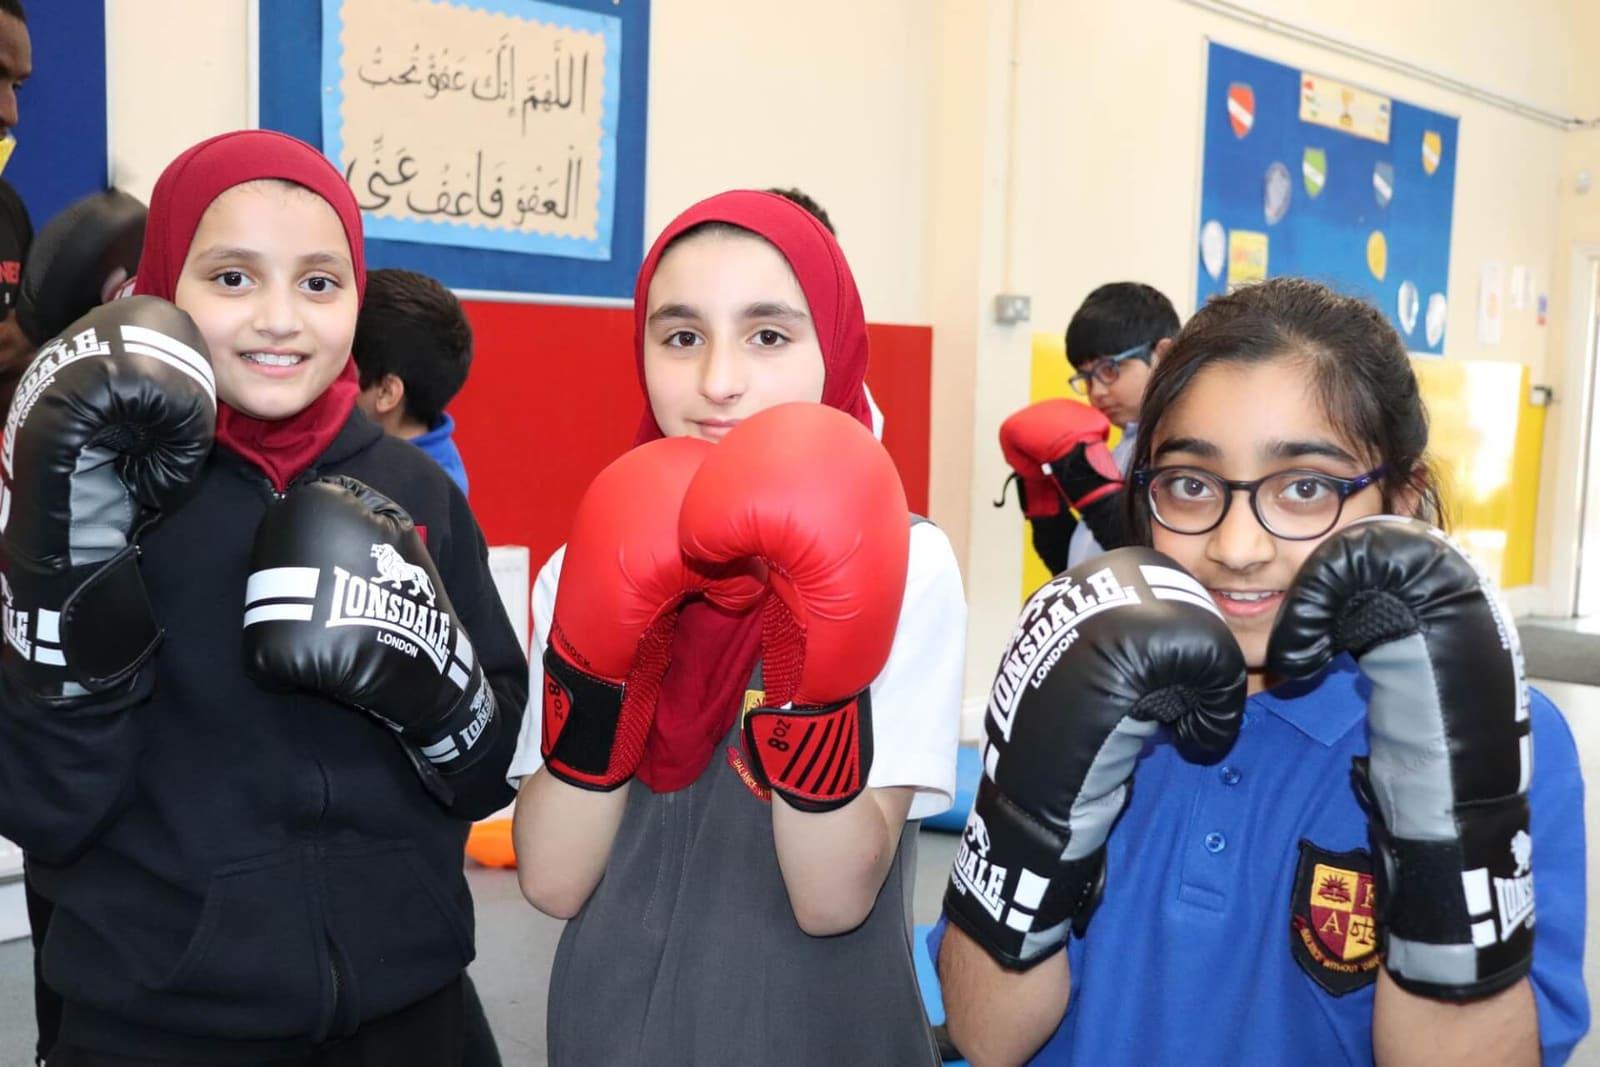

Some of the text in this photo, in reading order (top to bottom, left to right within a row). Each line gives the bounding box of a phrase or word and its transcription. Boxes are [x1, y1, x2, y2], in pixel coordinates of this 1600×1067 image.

[325, 565, 451, 676] LONSDALE
[376, 630, 419, 658] LONDON
[987, 566, 1142, 743] LONSDALE
[1031, 628, 1080, 689] LONDON
[1319, 910, 1344, 936] A
